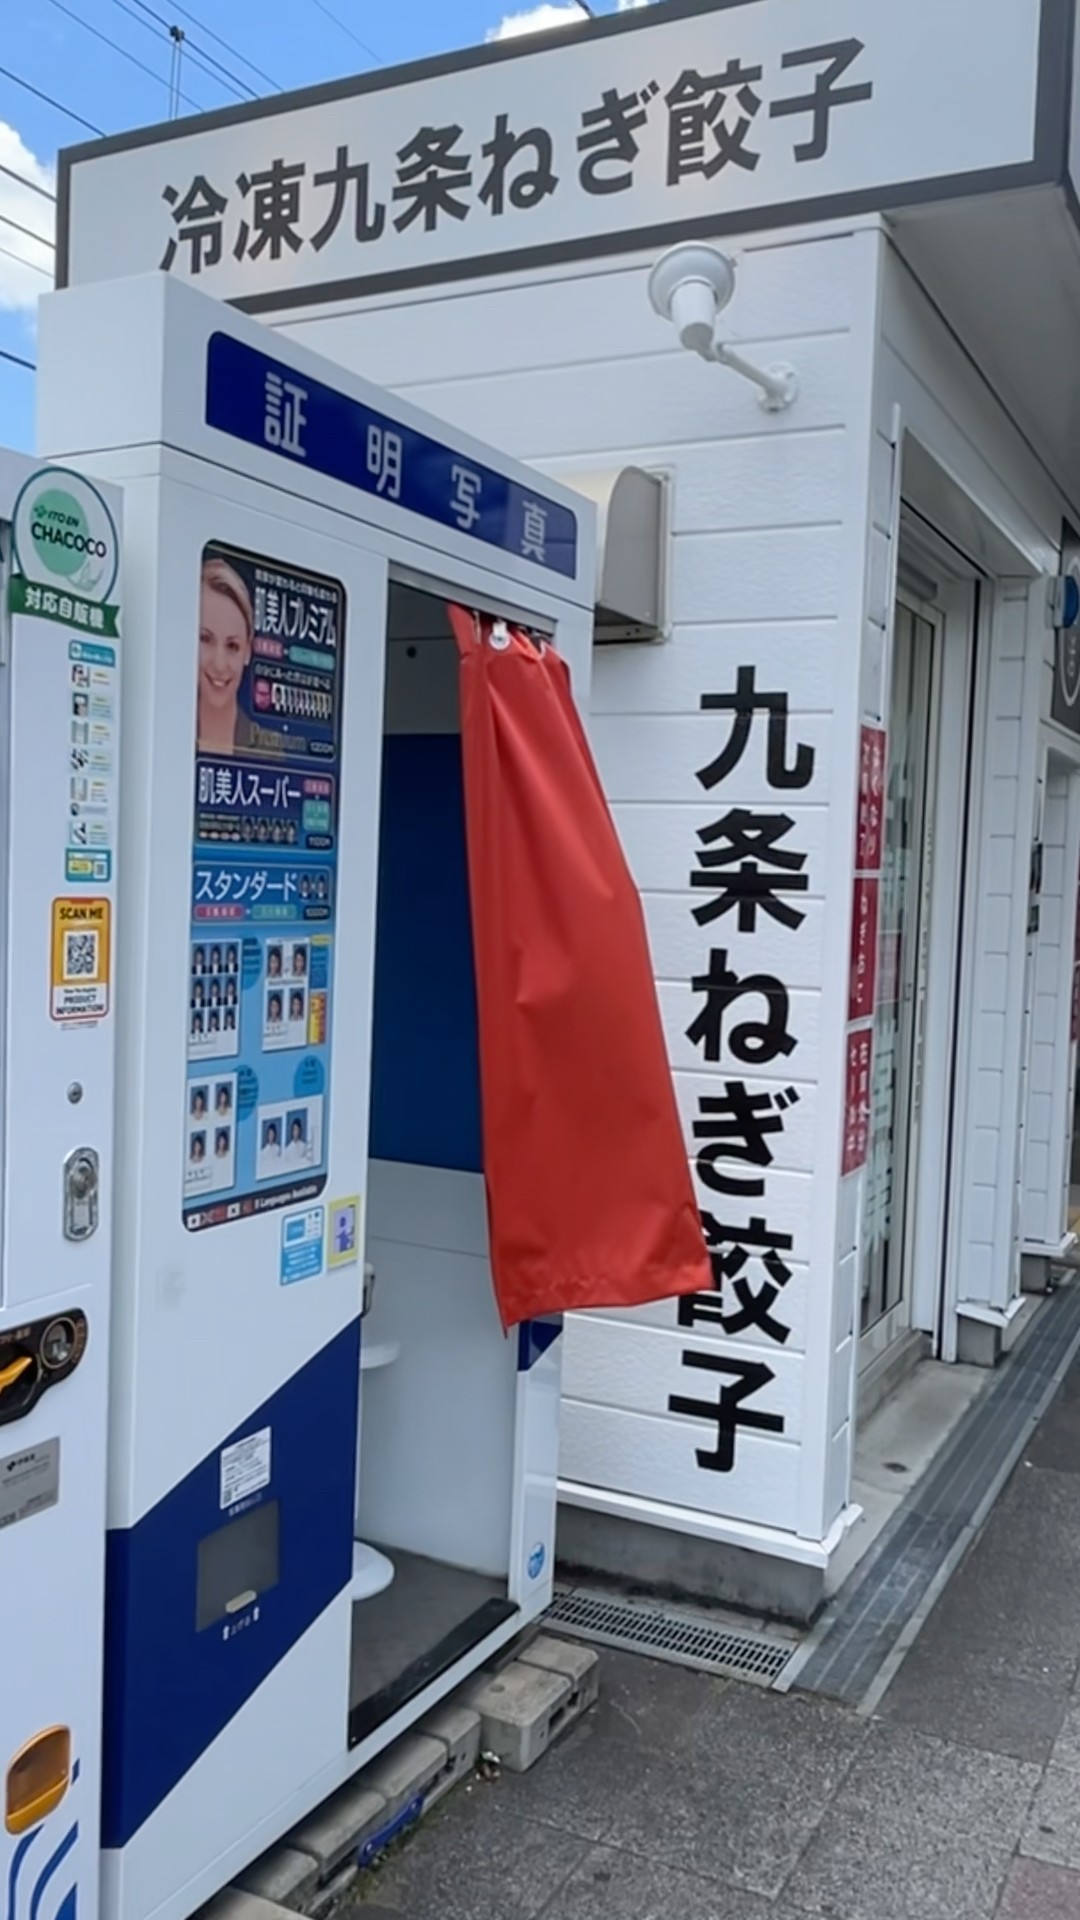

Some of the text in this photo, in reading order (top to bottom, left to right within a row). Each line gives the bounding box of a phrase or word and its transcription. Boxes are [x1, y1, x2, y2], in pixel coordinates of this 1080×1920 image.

[159, 37, 873, 275] 冷凍九条ねぎ餃子
[264, 372, 549, 564] 証明写真
[31, 522, 107, 558] CHACOCO
[25, 586, 104, 629] 対応自販機
[198, 766, 301, 808] 肌美人スーパー
[195, 870, 297, 902] スタンダード
[59, 907, 104, 920] SCAN ME
[64, 994, 97, 1004] PRODUCT
[668, 666, 815, 1473] 九条ねぎ餃子
